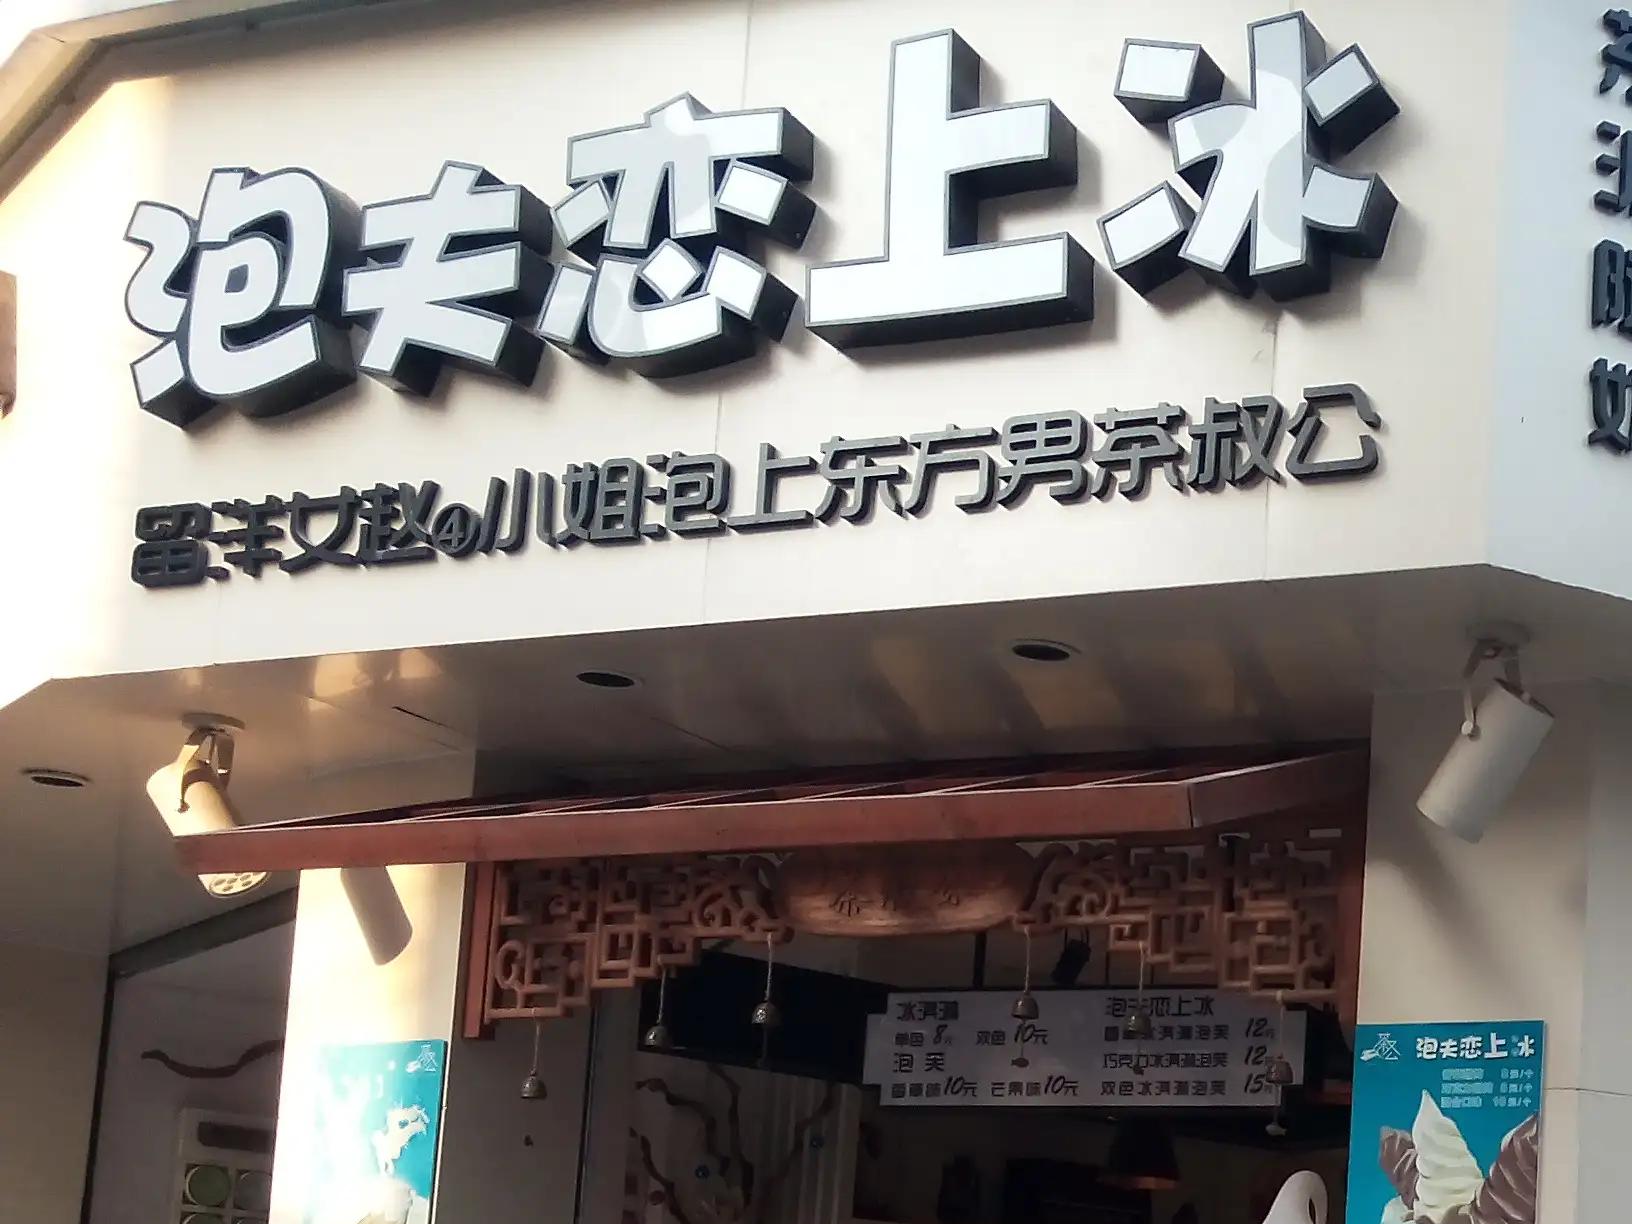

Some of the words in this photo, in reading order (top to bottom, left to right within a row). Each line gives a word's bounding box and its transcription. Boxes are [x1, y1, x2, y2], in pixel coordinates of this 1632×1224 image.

[124, 10, 1400, 425] 泡夫恋上冰
[1416, 1032, 1535, 1060] 泡夫恋上冰
